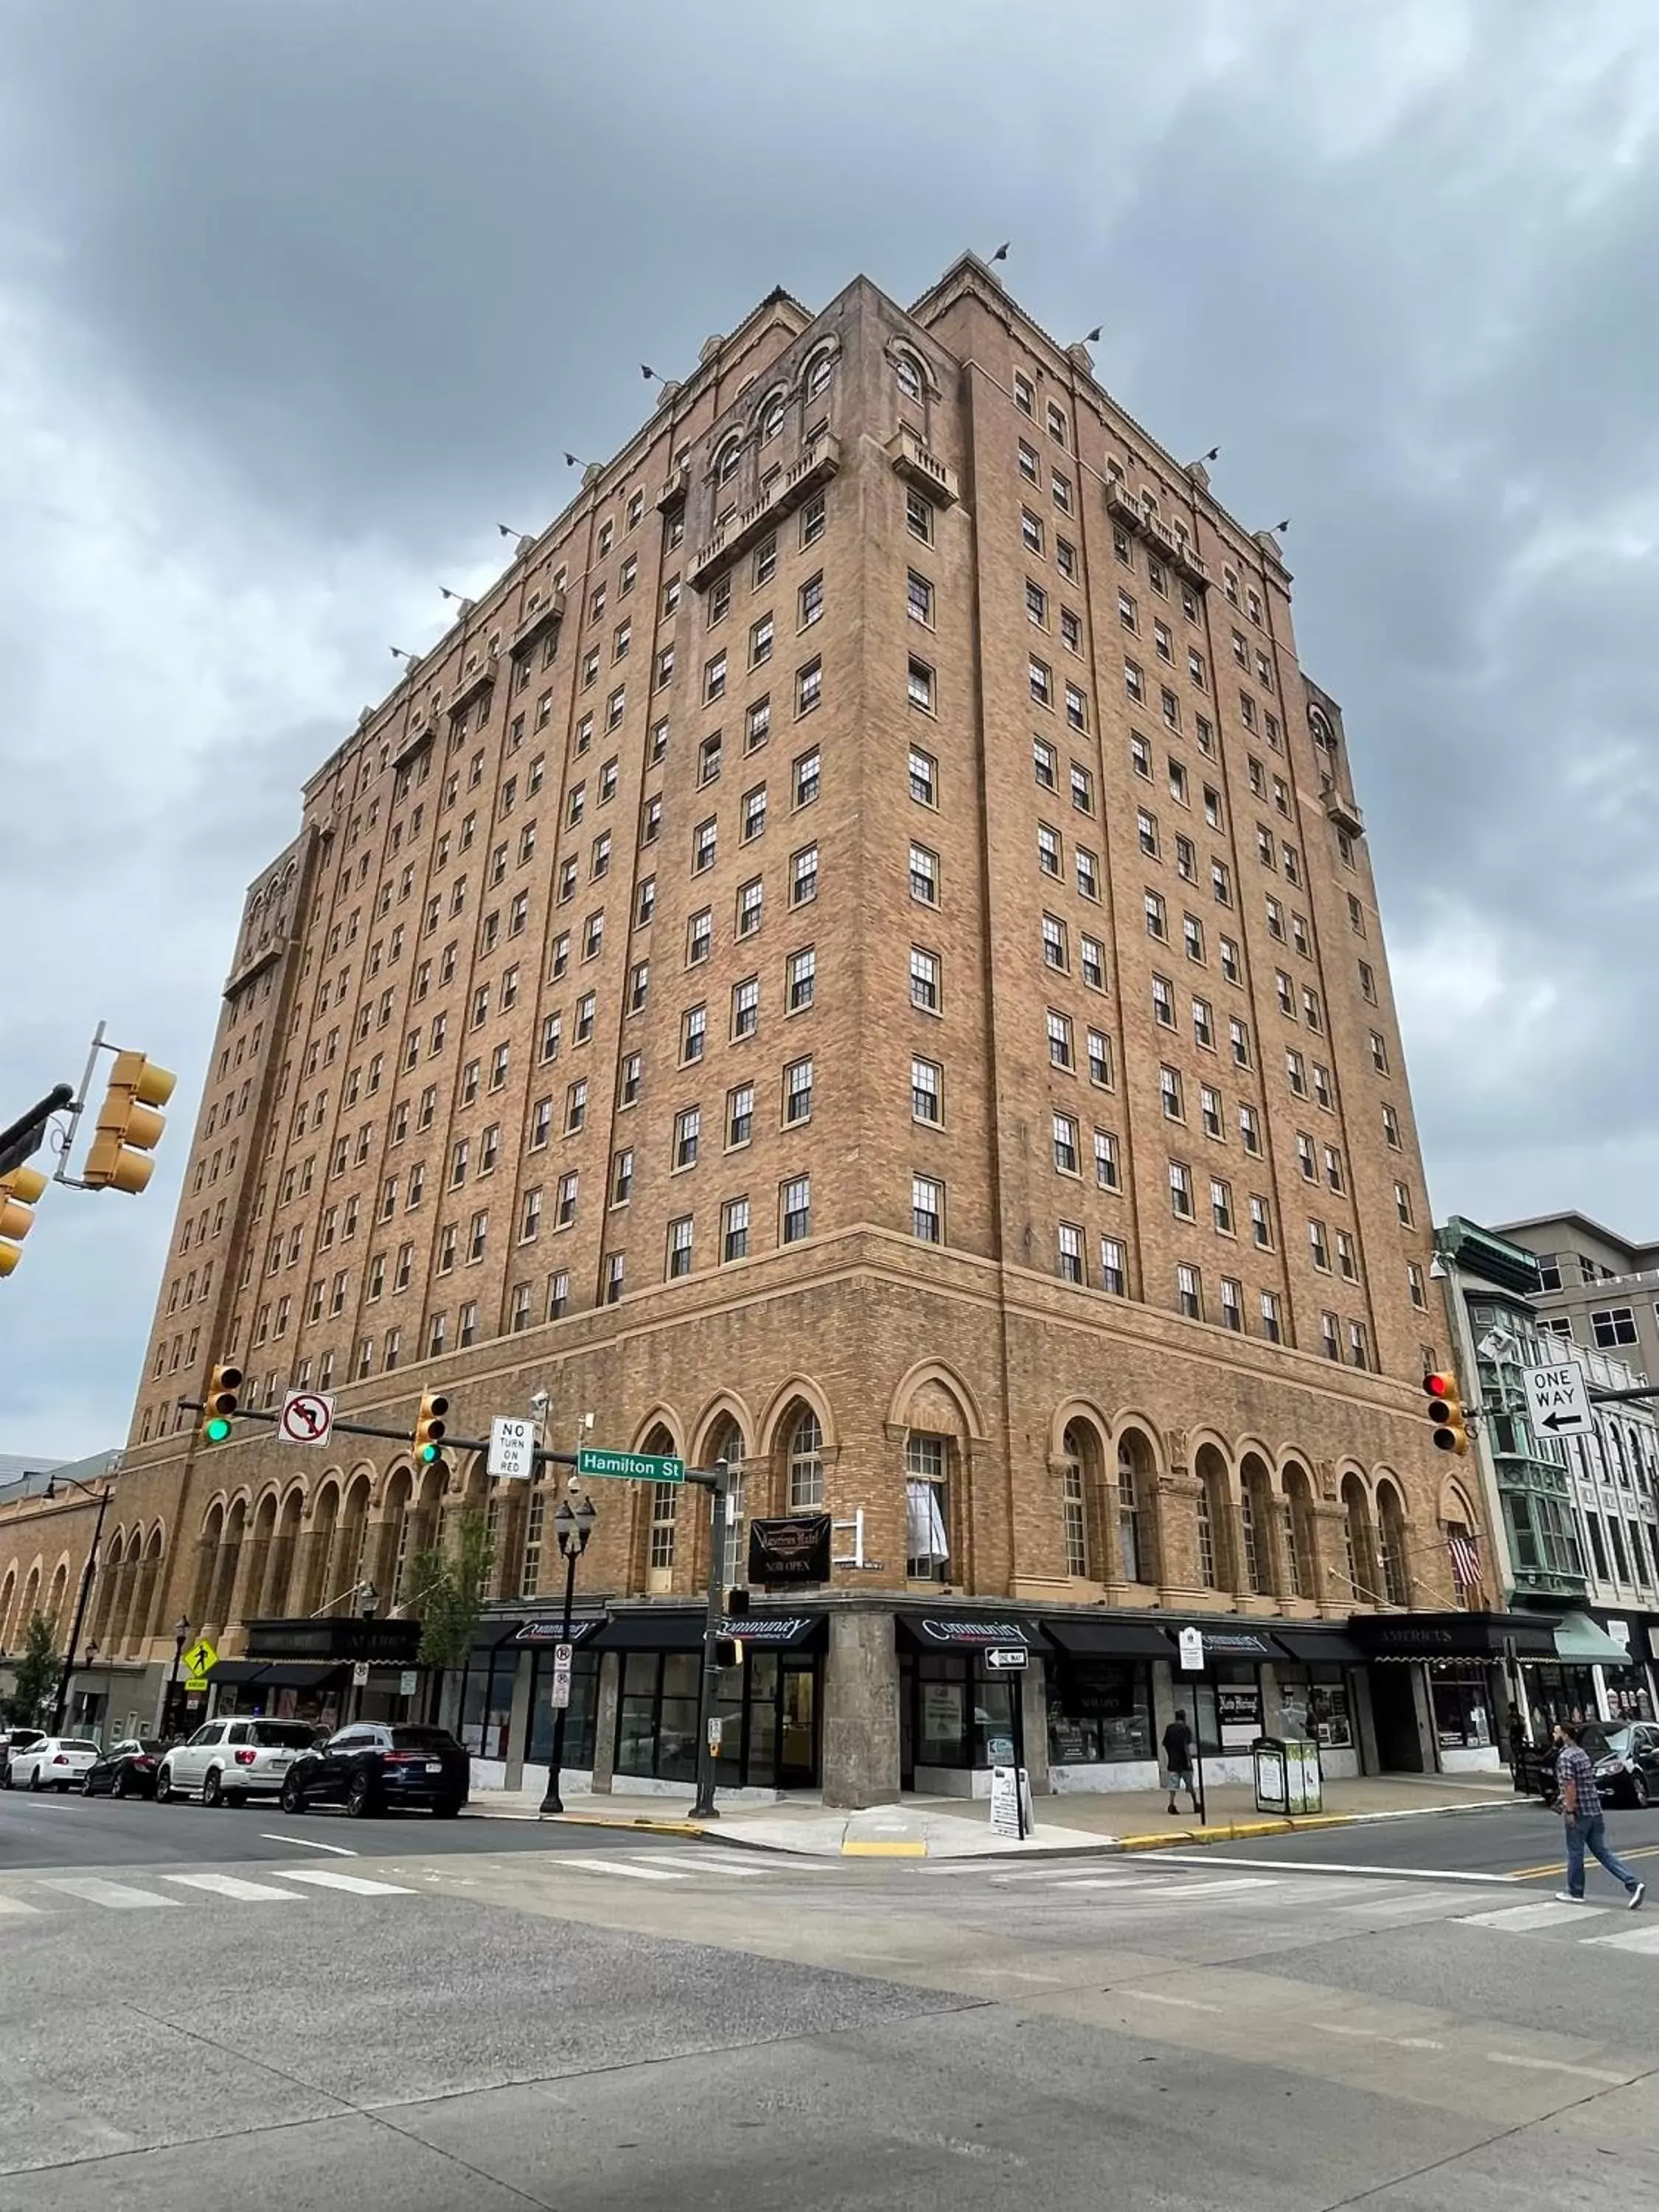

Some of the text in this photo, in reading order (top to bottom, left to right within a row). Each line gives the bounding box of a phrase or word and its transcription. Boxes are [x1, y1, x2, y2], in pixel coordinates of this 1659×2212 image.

[1534, 1370, 1572, 1388] ONE
[1536, 1388, 1574, 1407] WAY
[503, 1424, 524, 1436] NO
[501, 1439, 524, 1449] TURN
[504, 1450, 518, 1460] ON
[501, 1462, 520, 1472] RED
[584, 1454, 679, 1476] Hamilton St
[922, 1619, 1031, 1643] Community
